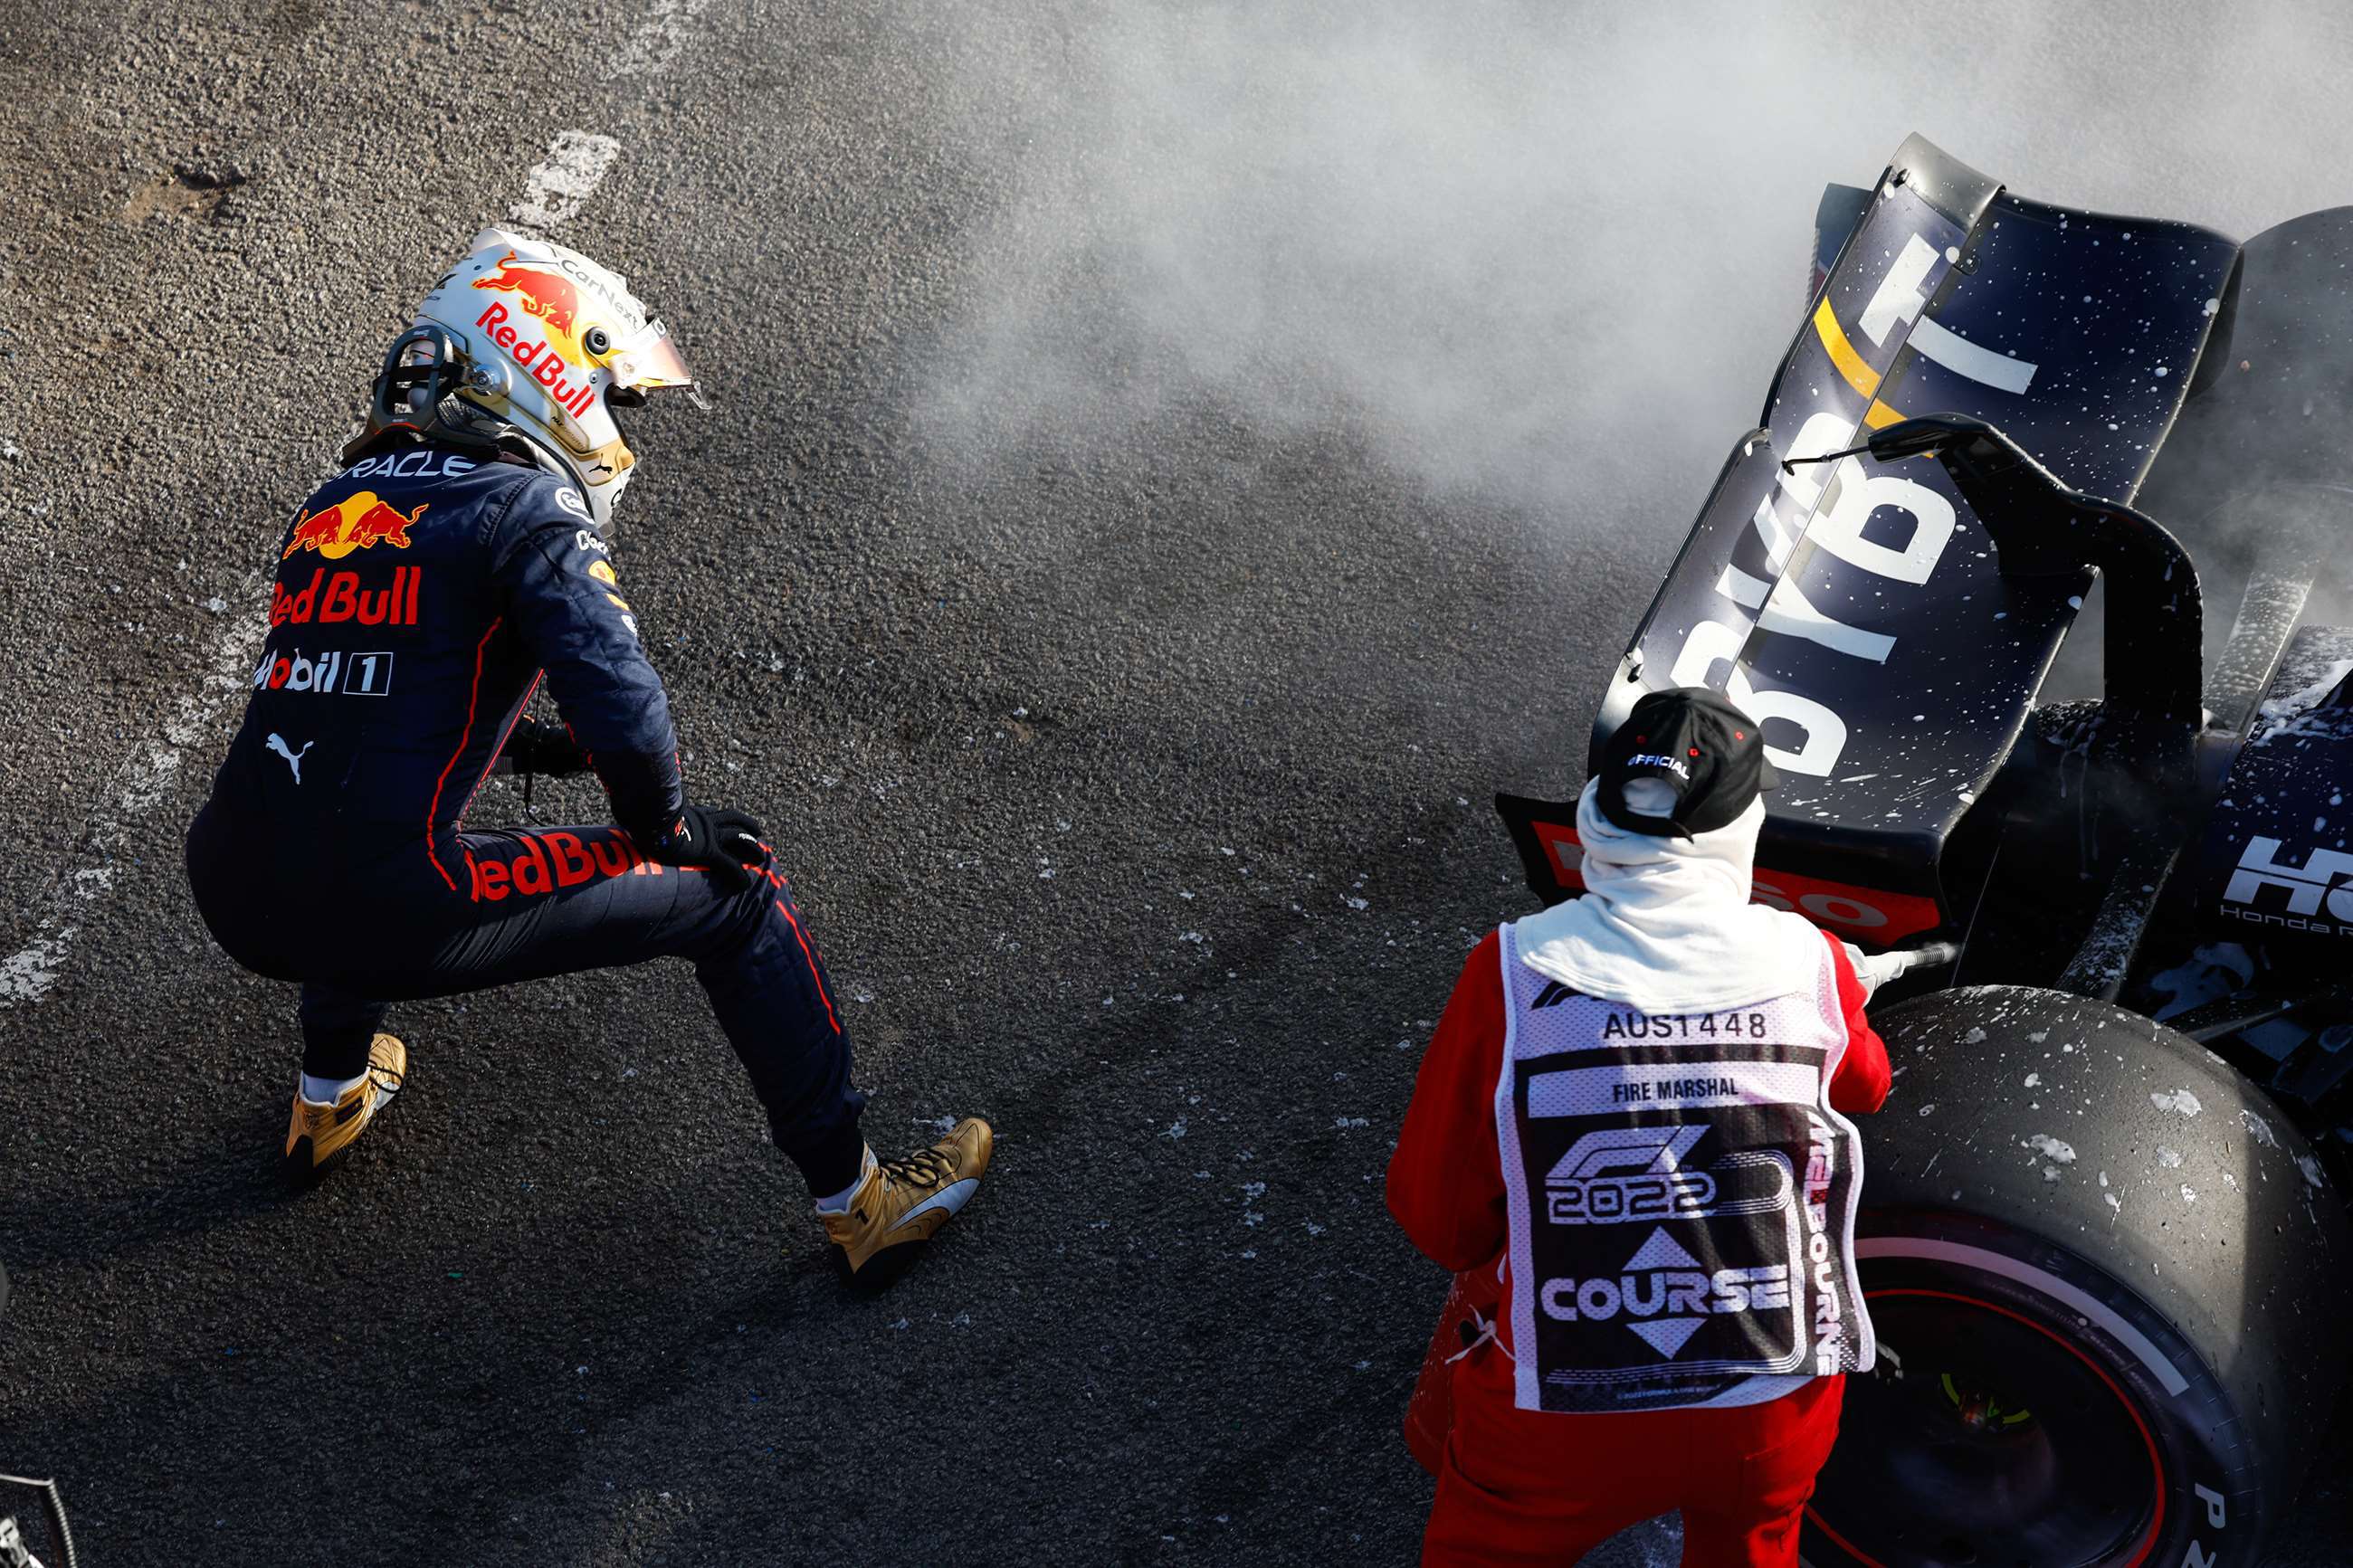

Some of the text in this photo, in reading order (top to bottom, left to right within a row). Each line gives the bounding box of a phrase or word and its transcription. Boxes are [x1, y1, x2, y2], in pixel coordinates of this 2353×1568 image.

[474, 300, 595, 419] Red Bull
[328, 451, 477, 482] RACLE
[319, 565, 422, 626] Bull
[1627, 753, 1690, 780] OFFICIAL
[2220, 904, 2330, 934] Honda
[1603, 1012, 1767, 1040] AUS1448
[1614, 1078, 1739, 1103] FIRE MARSHAL
[1545, 1172, 1717, 1225] 2022
[1540, 1264, 1790, 1322] COURSE
